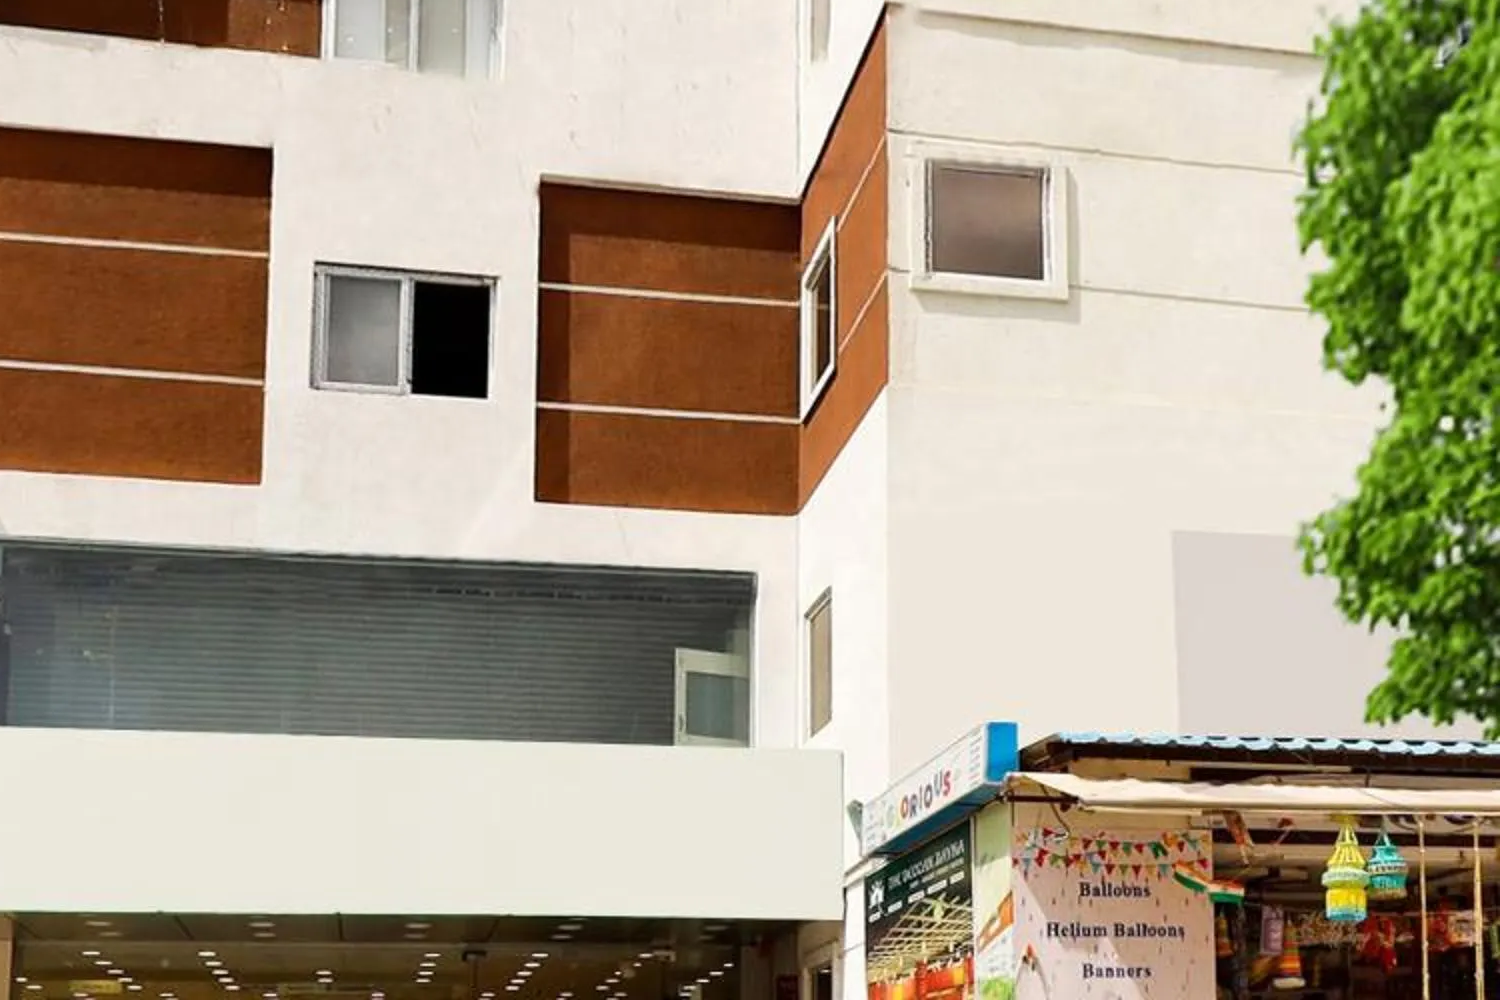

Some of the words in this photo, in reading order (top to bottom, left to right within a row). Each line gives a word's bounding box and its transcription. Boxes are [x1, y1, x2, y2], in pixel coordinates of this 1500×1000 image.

[885, 769, 952, 829] ORIOUS
[1078, 881, 1152, 898] Balloons
[1046, 922, 1108, 938] Helium
[1113, 922, 1186, 939] Balloons
[1082, 963, 1152, 979] Banners
